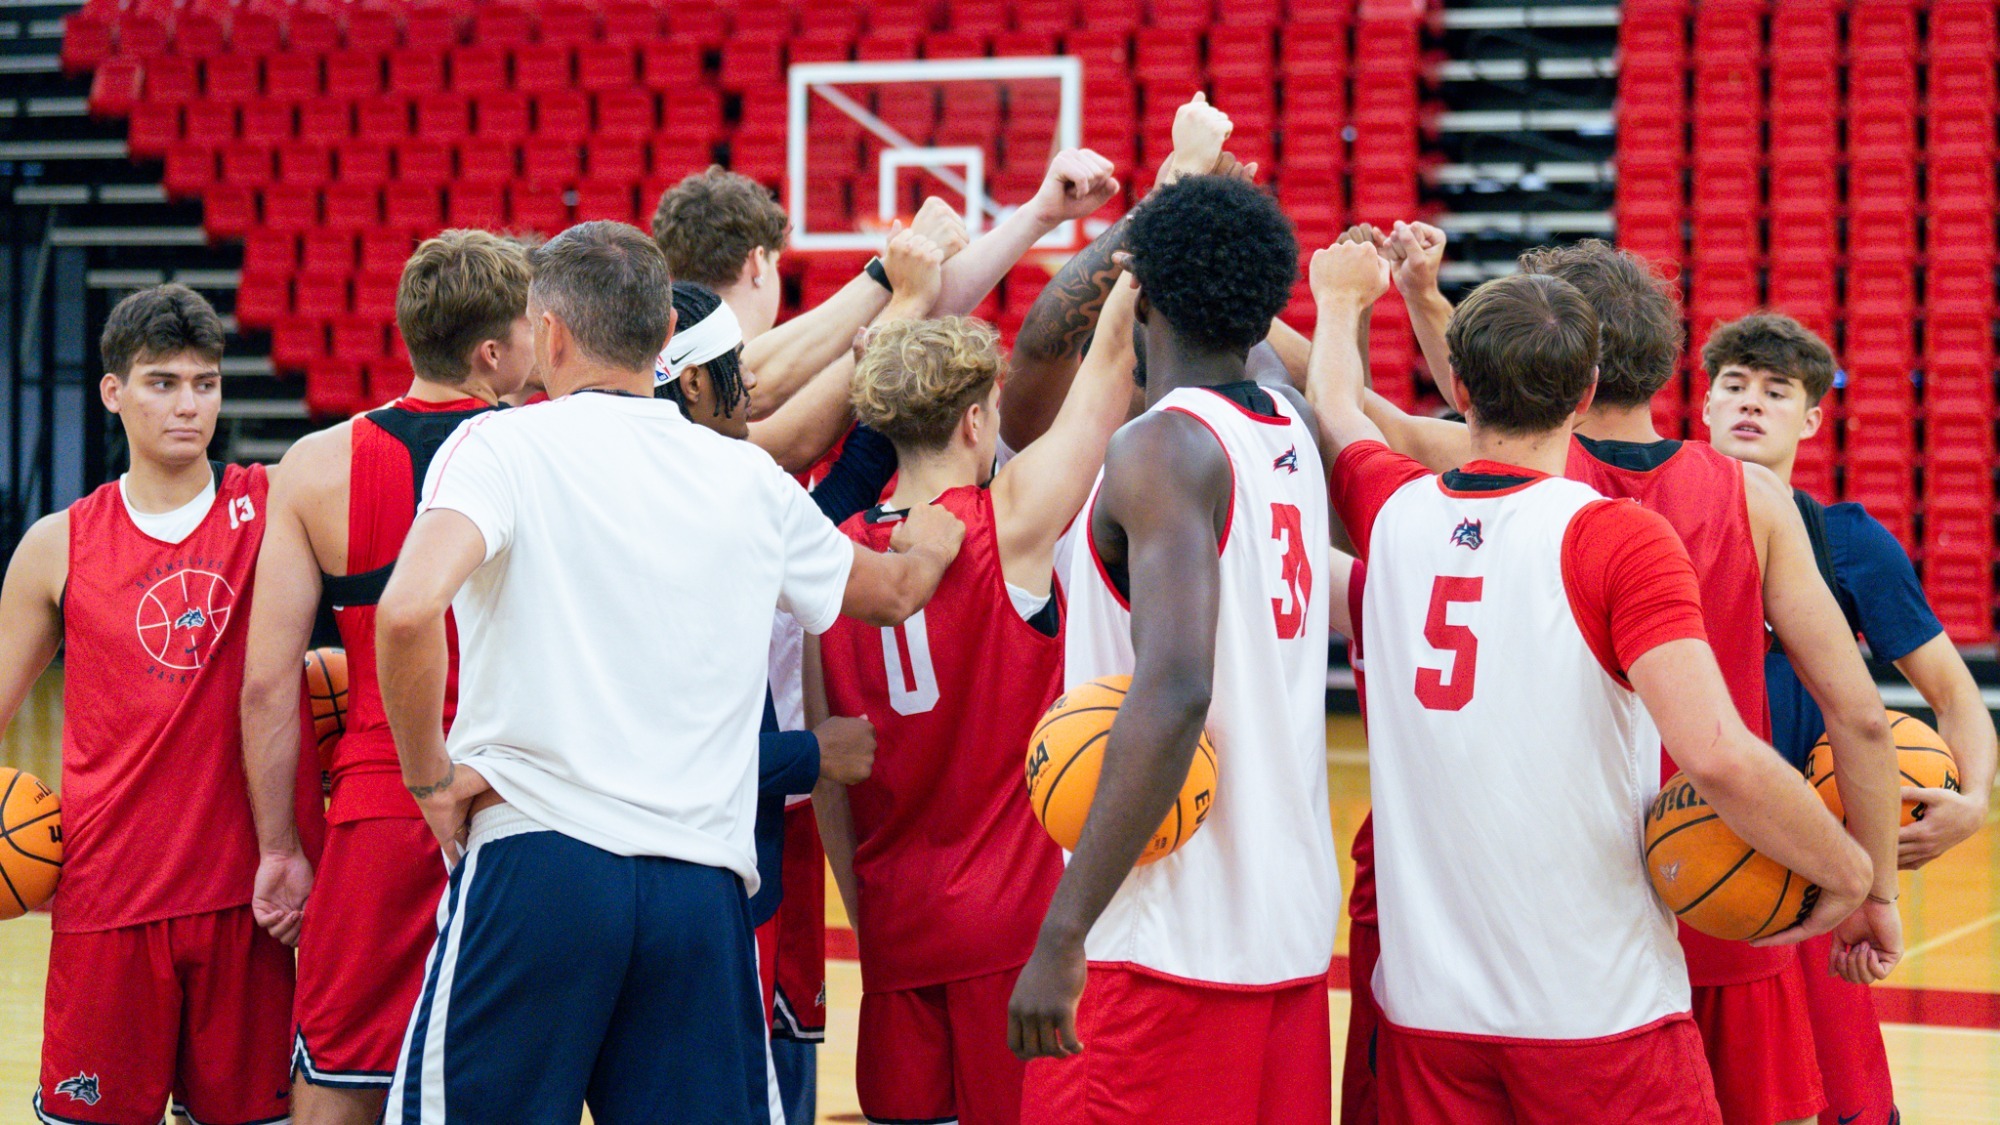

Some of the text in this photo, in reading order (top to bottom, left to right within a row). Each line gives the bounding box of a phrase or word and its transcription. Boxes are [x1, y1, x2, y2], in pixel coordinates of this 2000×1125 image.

[228, 494, 256, 530] 13
[135, 556, 225, 590] SEAWOLVES
[1413, 574, 1485, 712] 5
[1026, 739, 1050, 797] CAA
